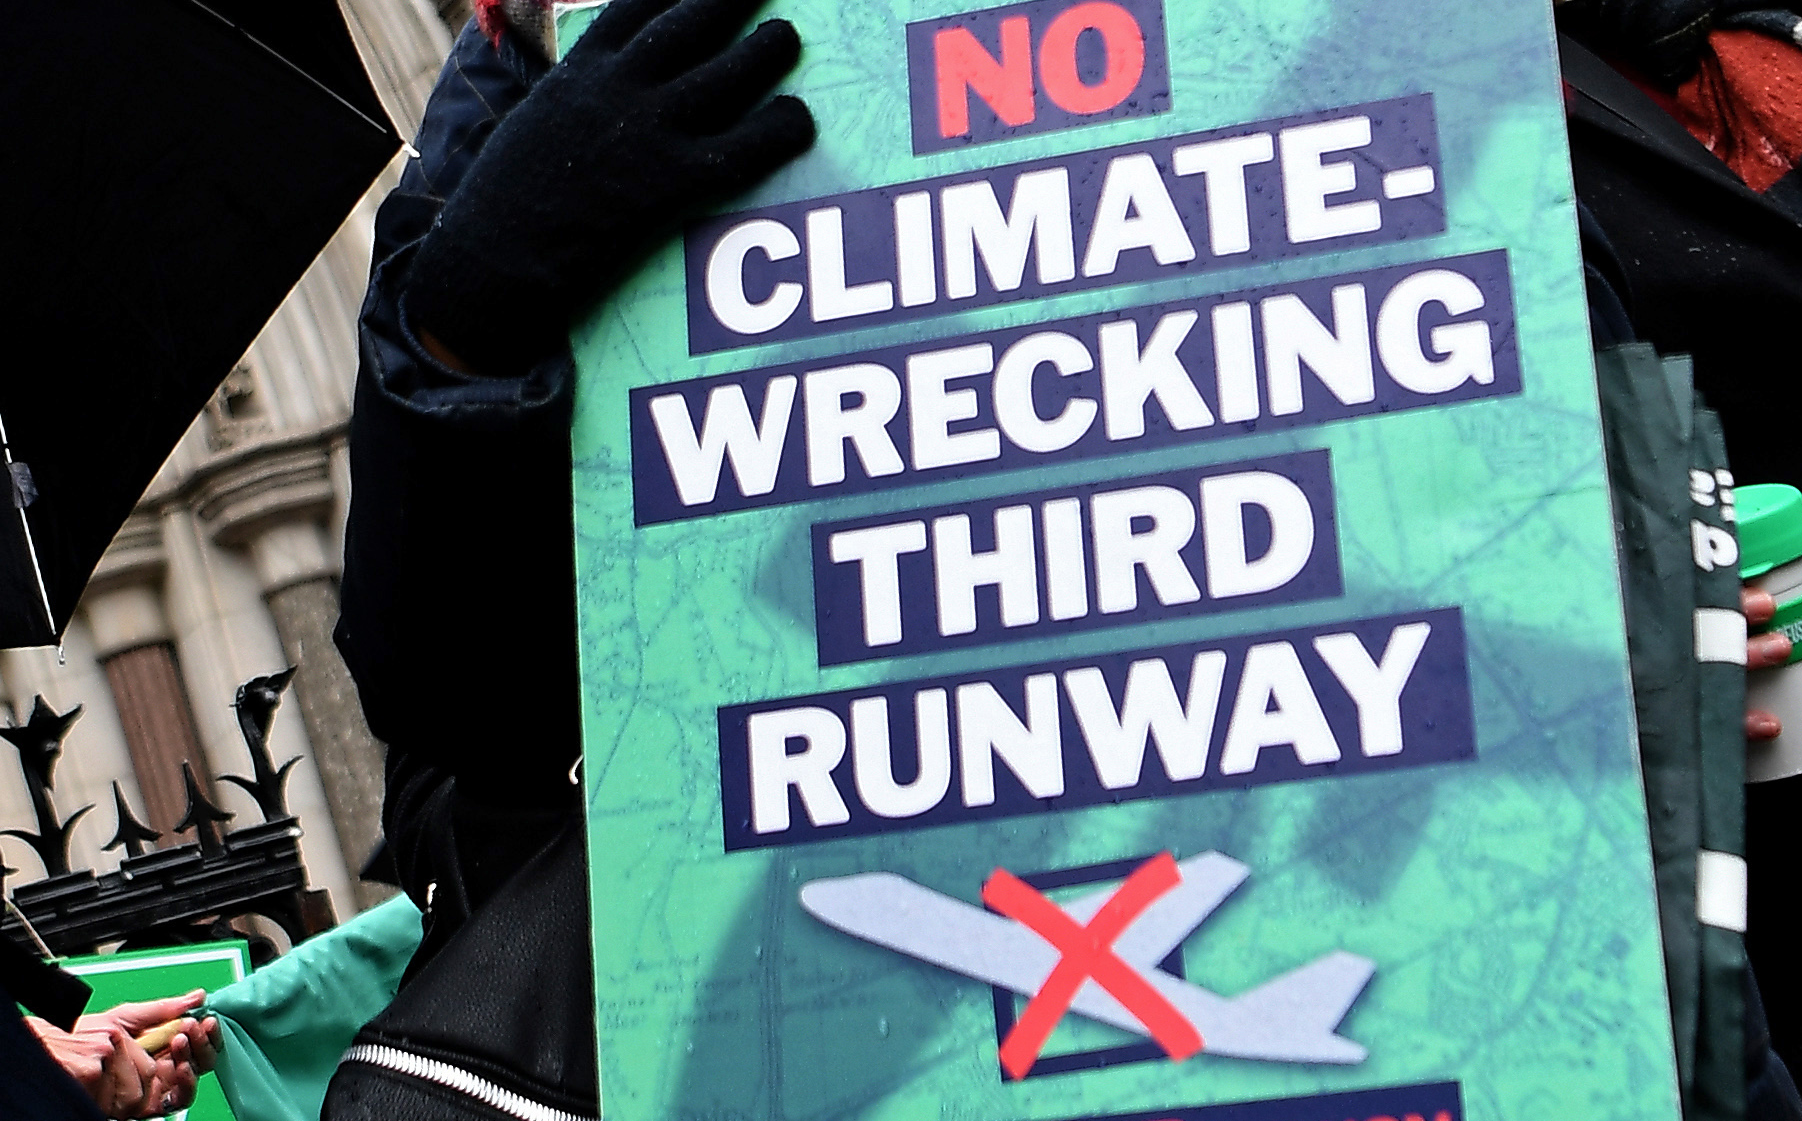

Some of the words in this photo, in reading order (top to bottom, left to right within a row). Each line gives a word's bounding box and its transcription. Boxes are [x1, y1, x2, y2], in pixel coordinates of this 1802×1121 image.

[936, 1, 1145, 138] NO
[706, 115, 1435, 335] CLIMATE-
[650, 269, 1494, 506] WRECKING
[830, 471, 1315, 647] THIRD
[748, 622, 1432, 835] RUNWAY
